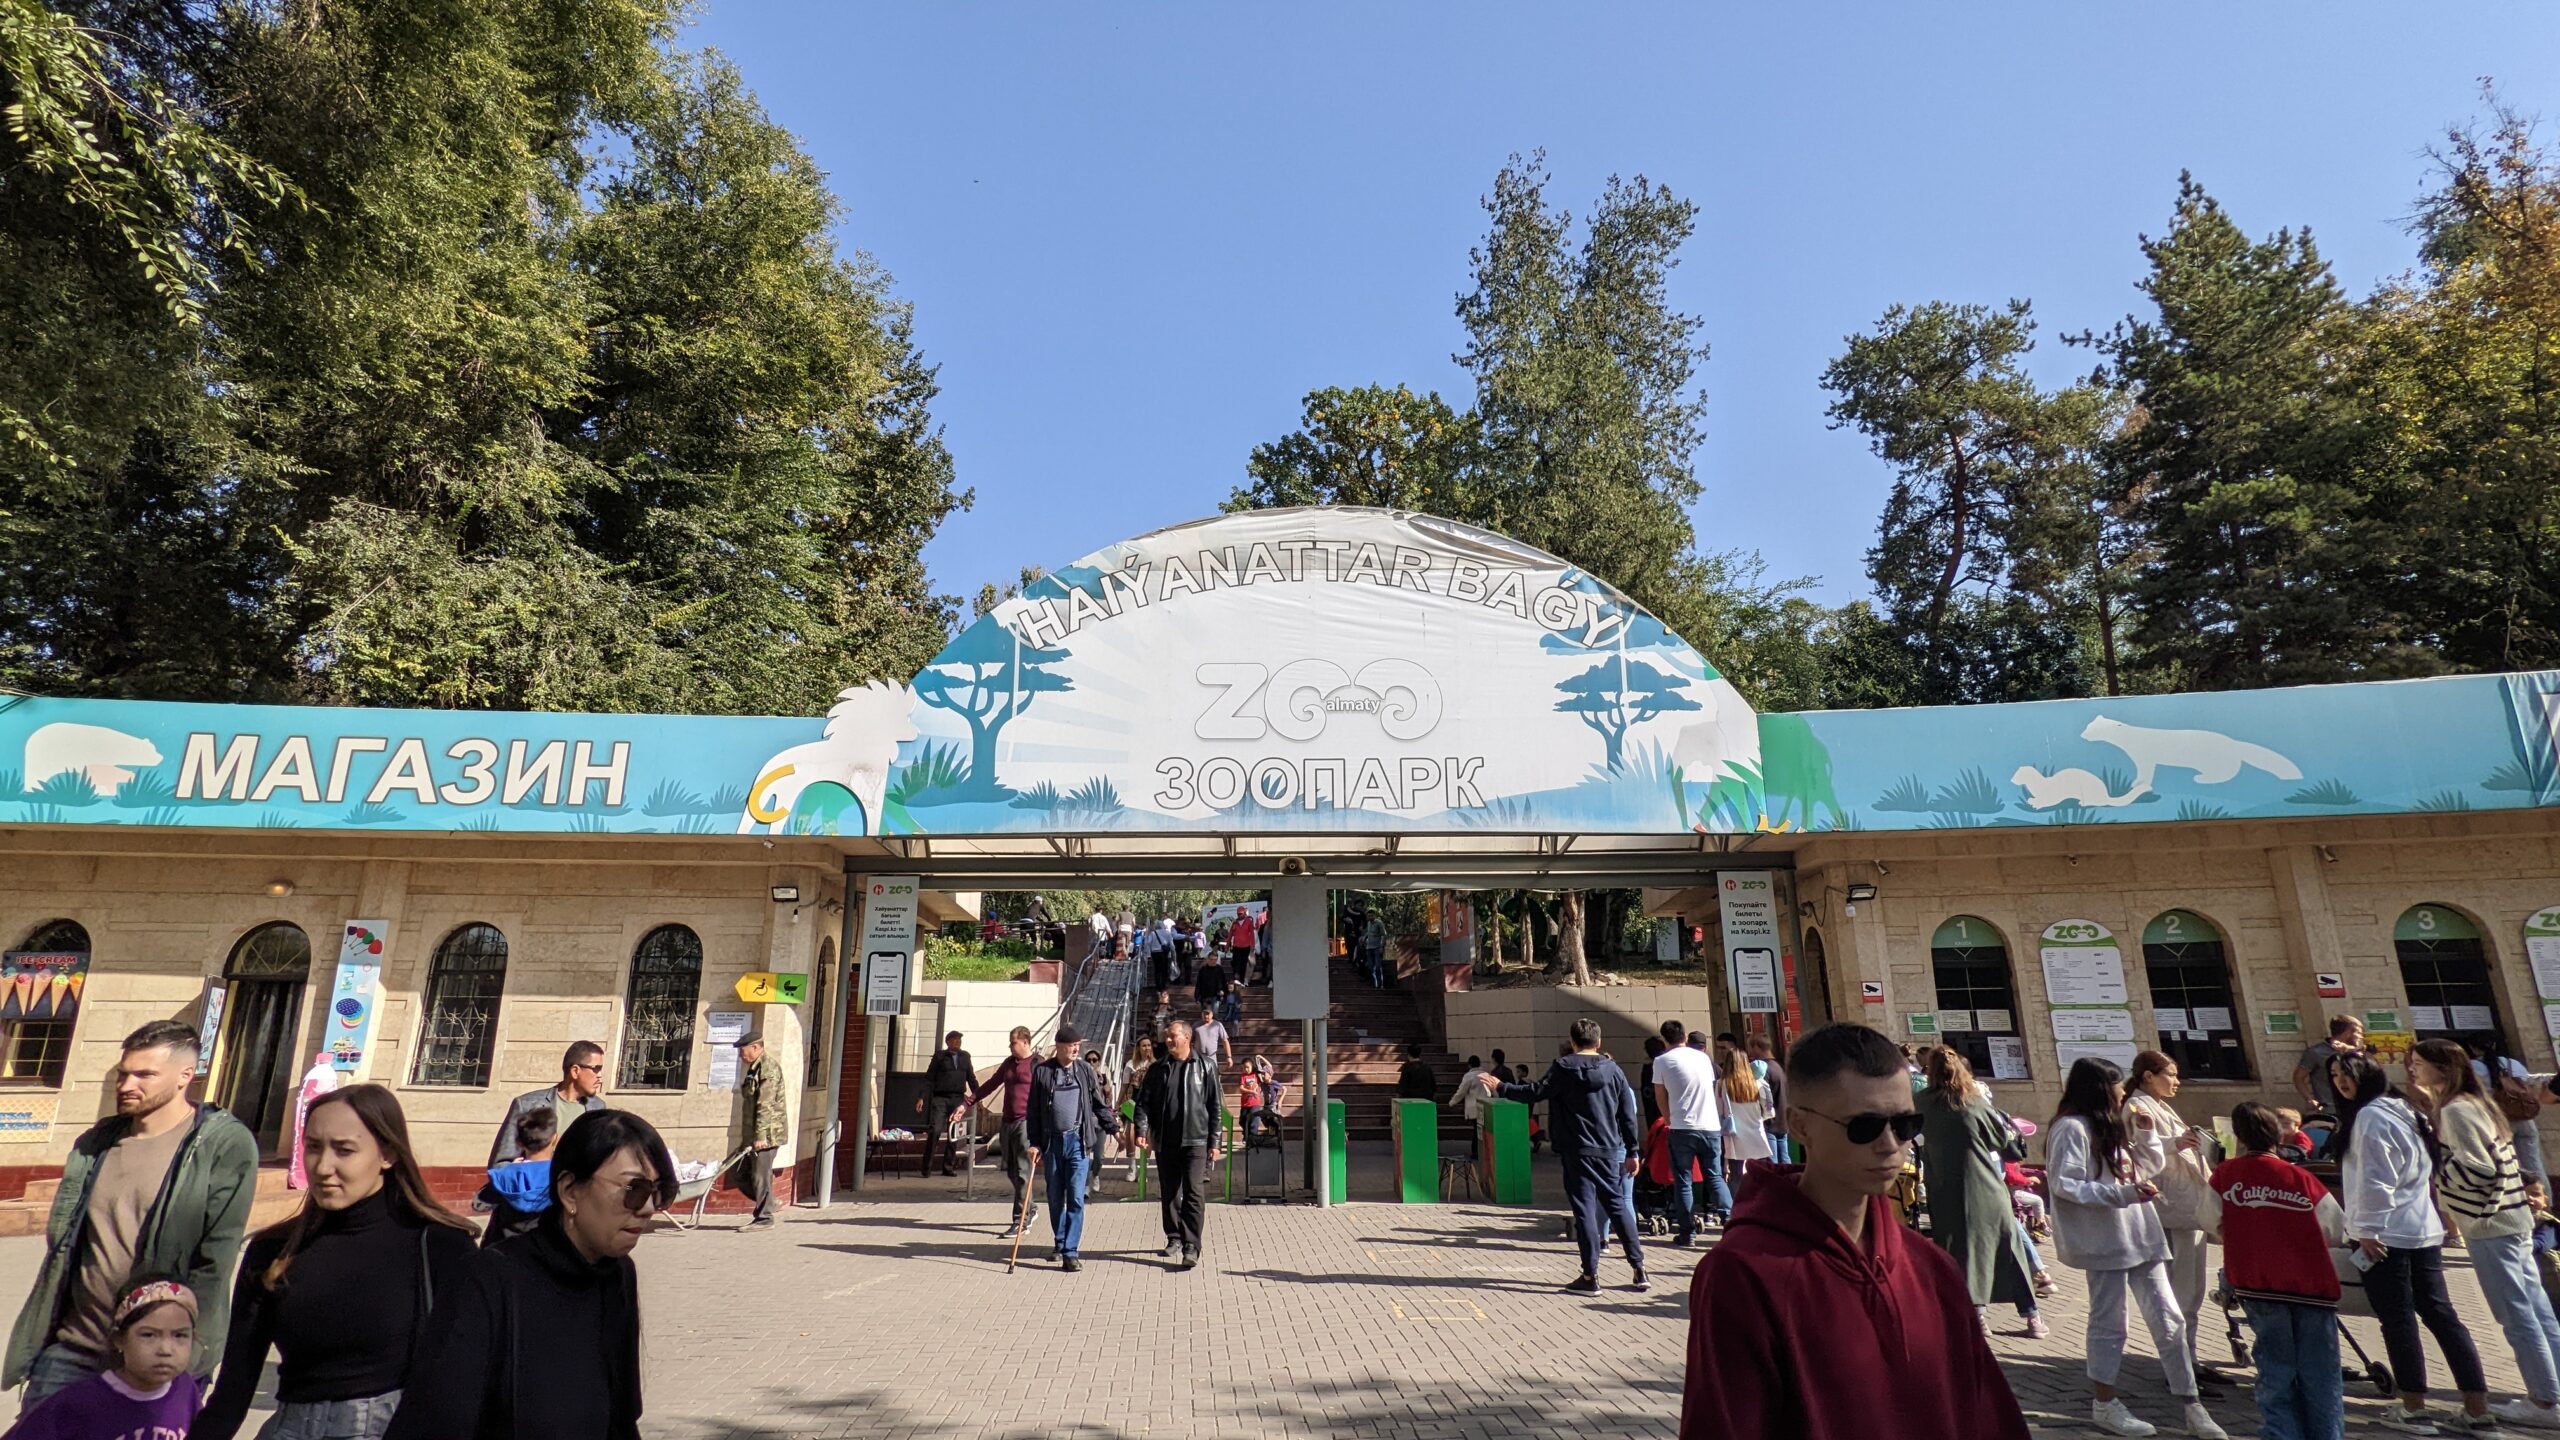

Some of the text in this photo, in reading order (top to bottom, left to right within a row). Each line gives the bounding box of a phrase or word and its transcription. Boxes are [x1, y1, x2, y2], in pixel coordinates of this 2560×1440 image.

[1017, 540, 1432, 650] HAIÝANATTAR
[1194, 658, 1443, 742] ZOO
[1326, 697, 1381, 715] almaty
[175, 732, 631, 806] МАГАЗИН
[1154, 757, 1486, 810] ЗООПАРК
[1956, 920, 1967, 939] 1
[2165, 915, 2182, 934] 2
[2418, 910, 2436, 930] 3
[1741, 928, 1771, 936] Kaspi.kz
[2053, 924, 2099, 939] ZOO
[2223, 1182, 2312, 1208] California
